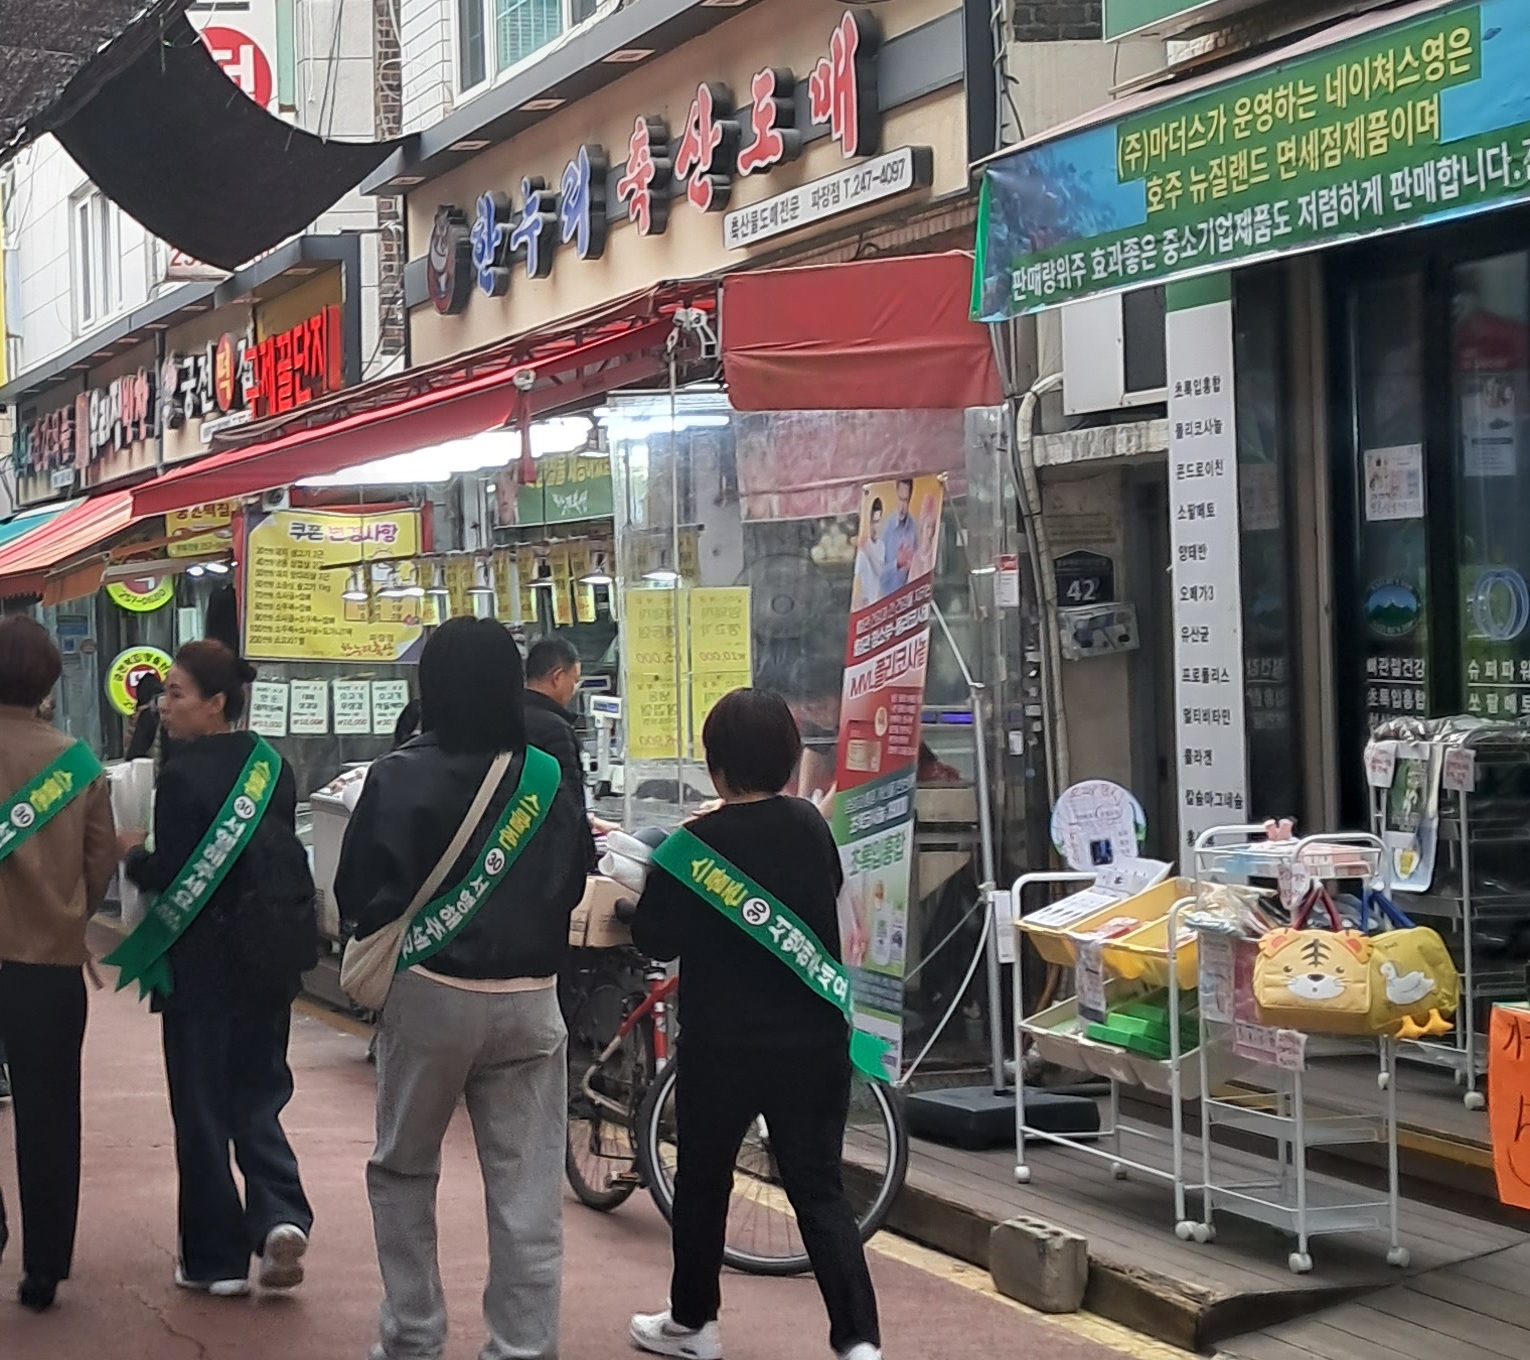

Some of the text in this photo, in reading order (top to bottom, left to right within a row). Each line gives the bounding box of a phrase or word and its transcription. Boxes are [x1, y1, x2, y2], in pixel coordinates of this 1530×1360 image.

[617, 9, 860, 237] 축산도매
[1116, 25, 1474, 178] (주)마더스가 운영하는 네이쳐스영은
[1146, 95, 1440, 213] 호주 뉴질랜드 면세점제품이며
[730, 194, 800, 241] 축산물도매전문
[1011, 252, 1086, 302] 판매량위주
[1090, 235, 1159, 280] 효과좋은
[1163, 198, 1294, 264] 중소기업제품도
[1298, 181, 1384, 229] 저렴하게
[289, 522, 324, 541] 쿠폰
[1067, 578, 1098, 601] 42
